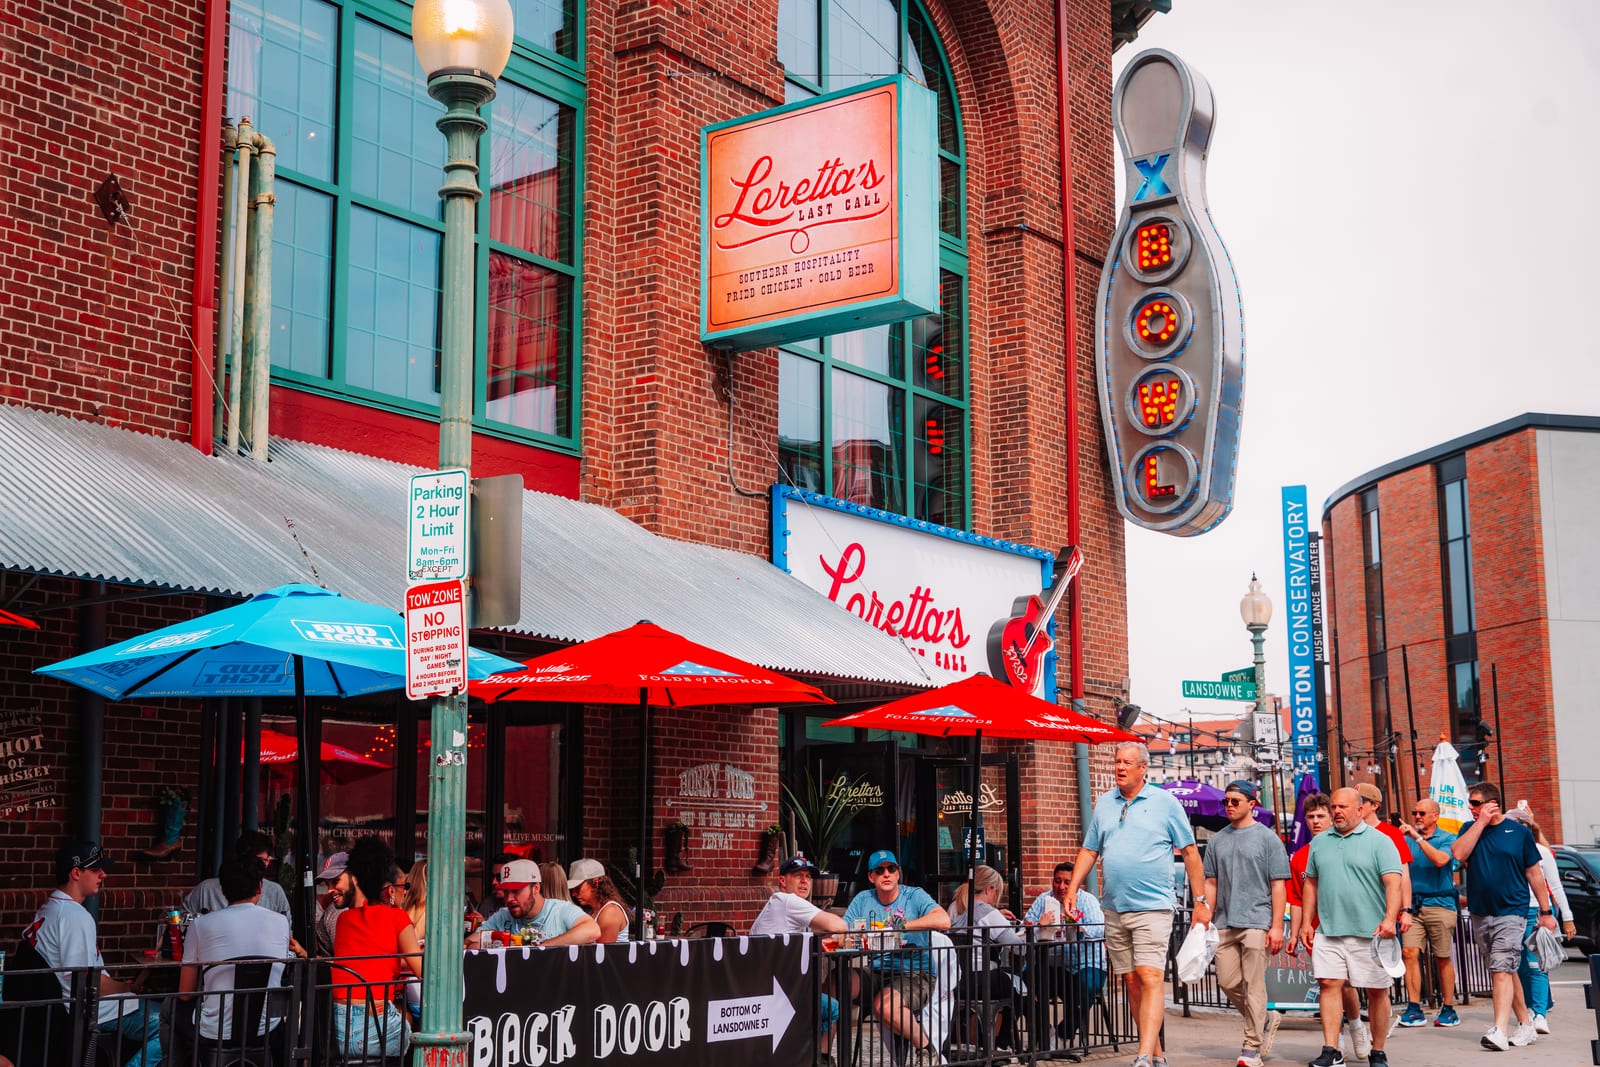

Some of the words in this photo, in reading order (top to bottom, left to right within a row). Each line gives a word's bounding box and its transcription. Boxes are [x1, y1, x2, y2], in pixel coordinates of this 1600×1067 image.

[714, 155, 885, 228] Loretta's
[798, 203, 833, 222] LAST
[845, 192, 881, 211] CALL
[739, 265, 788, 285] SOUTHERN
[794, 249, 861, 272] HOSPITALITY
[726, 283, 756, 303] FRIED
[761, 277, 803, 296] CHICKEN
[818, 270, 842, 284] COLD
[848, 262, 875, 277] BEER
[1137, 222, 1179, 499] BOWL
[414, 484, 463, 501] Parking
[416, 505, 425, 519] 2
[429, 503, 460, 518] Hour
[421, 522, 454, 537] Limit
[420, 545, 455, 555] Mon-Fri
[416, 557, 459, 567] 8am-6pm
[1309, 541, 1319, 585] THEATER
[1286, 500, 1310, 657] CONSERVATORY
[409, 592, 431, 607] TOW
[433, 588, 460, 604] ZONE
[819, 542, 970, 649] Loretta's
[1311, 591, 1321, 626] DANCE
[424, 611, 445, 627] NO
[311, 622, 377, 636] BUD
[411, 625, 460, 643] STOPPING
[305, 630, 394, 647] LIGHT
[1314, 629, 1324, 662] MUSIC
[413, 646, 434, 655] DURING
[447, 642, 459, 650] SOX
[420, 655, 431, 663] DAY
[434, 652, 452, 660] NIGHT
[426, 662, 446, 670] GAMES
[935, 651, 967, 673] CALL
[420, 671, 437, 679] HOURS
[437, 669, 457, 677] BEFORE
[478, 674, 591, 684] Budweiser
[639, 674, 692, 682] FOLDS
[712, 676, 774, 685] HONOR
[1184, 681, 1242, 698] LANSDOWNE
[1246, 690, 1253, 698] ST
[1294, 664, 1314, 745] BOSTON
[885, 713, 926, 721] FOLDS
[943, 716, 993, 725] HONOR
[1259, 717, 1275, 725] WEIGH
[8, 757, 25, 769] OF
[679, 763, 720, 798] HONKY
[829, 775, 884, 801] Loretta's
[35, 797, 56, 809] TEA
[512, 833, 529, 841] LIVE
[531, 833, 555, 842] MUSIC
[702, 832, 734, 849] FENWAY
[720, 1005, 751, 1019] BOTTOM
[752, 1004, 762, 1016] OF
[467, 1004, 577, 1067] BACK
[594, 996, 691, 1060] DOOR
[713, 1019, 759, 1035] LANSDOWNE
[760, 1018, 769, 1030] ST
